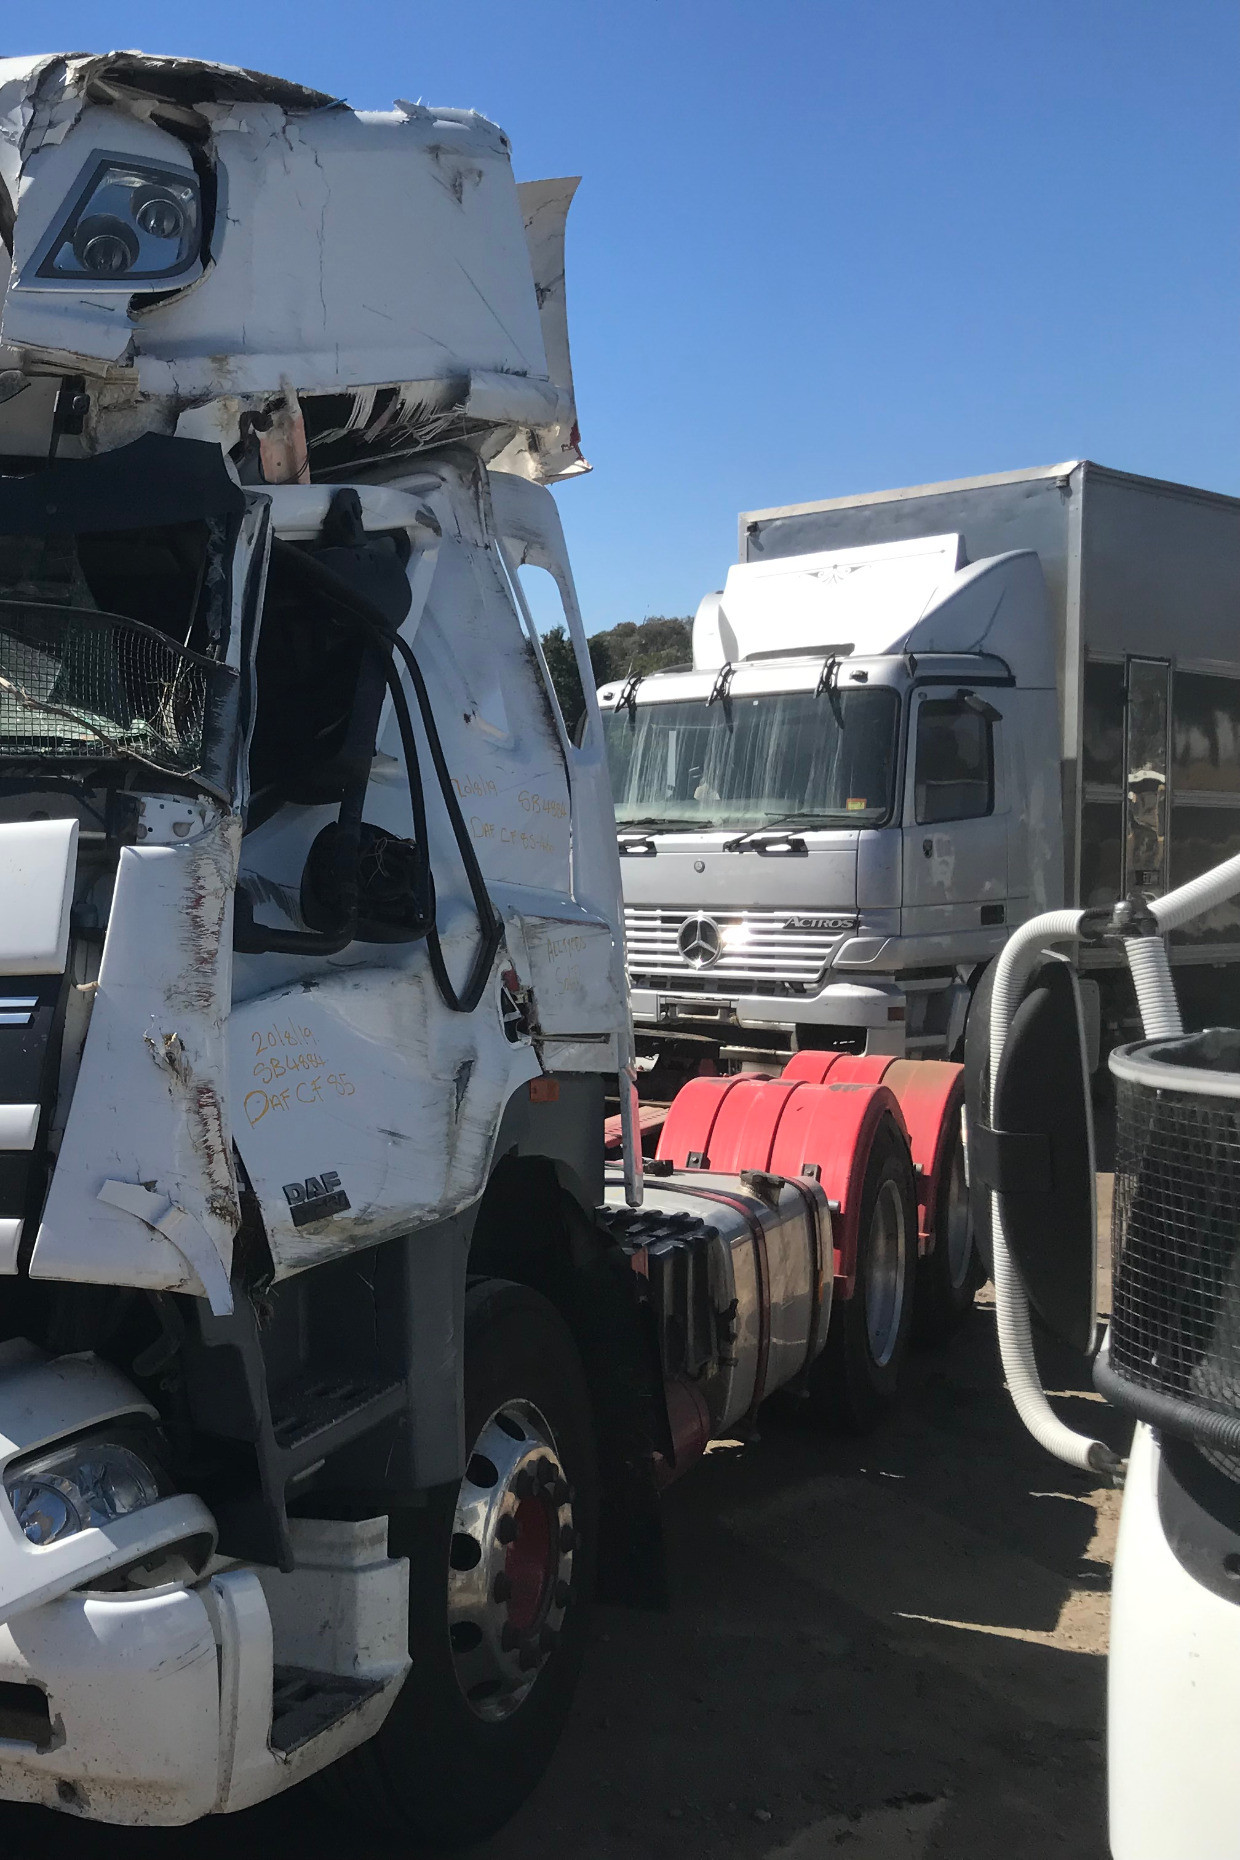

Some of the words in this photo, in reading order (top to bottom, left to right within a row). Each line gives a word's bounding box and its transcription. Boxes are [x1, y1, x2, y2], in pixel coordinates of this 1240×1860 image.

[251, 1016, 318, 1056] 20/8/19
[243, 1088, 290, 1130] DAF
[296, 1076, 324, 1103] CF
[282, 1171, 341, 1205] DAF
